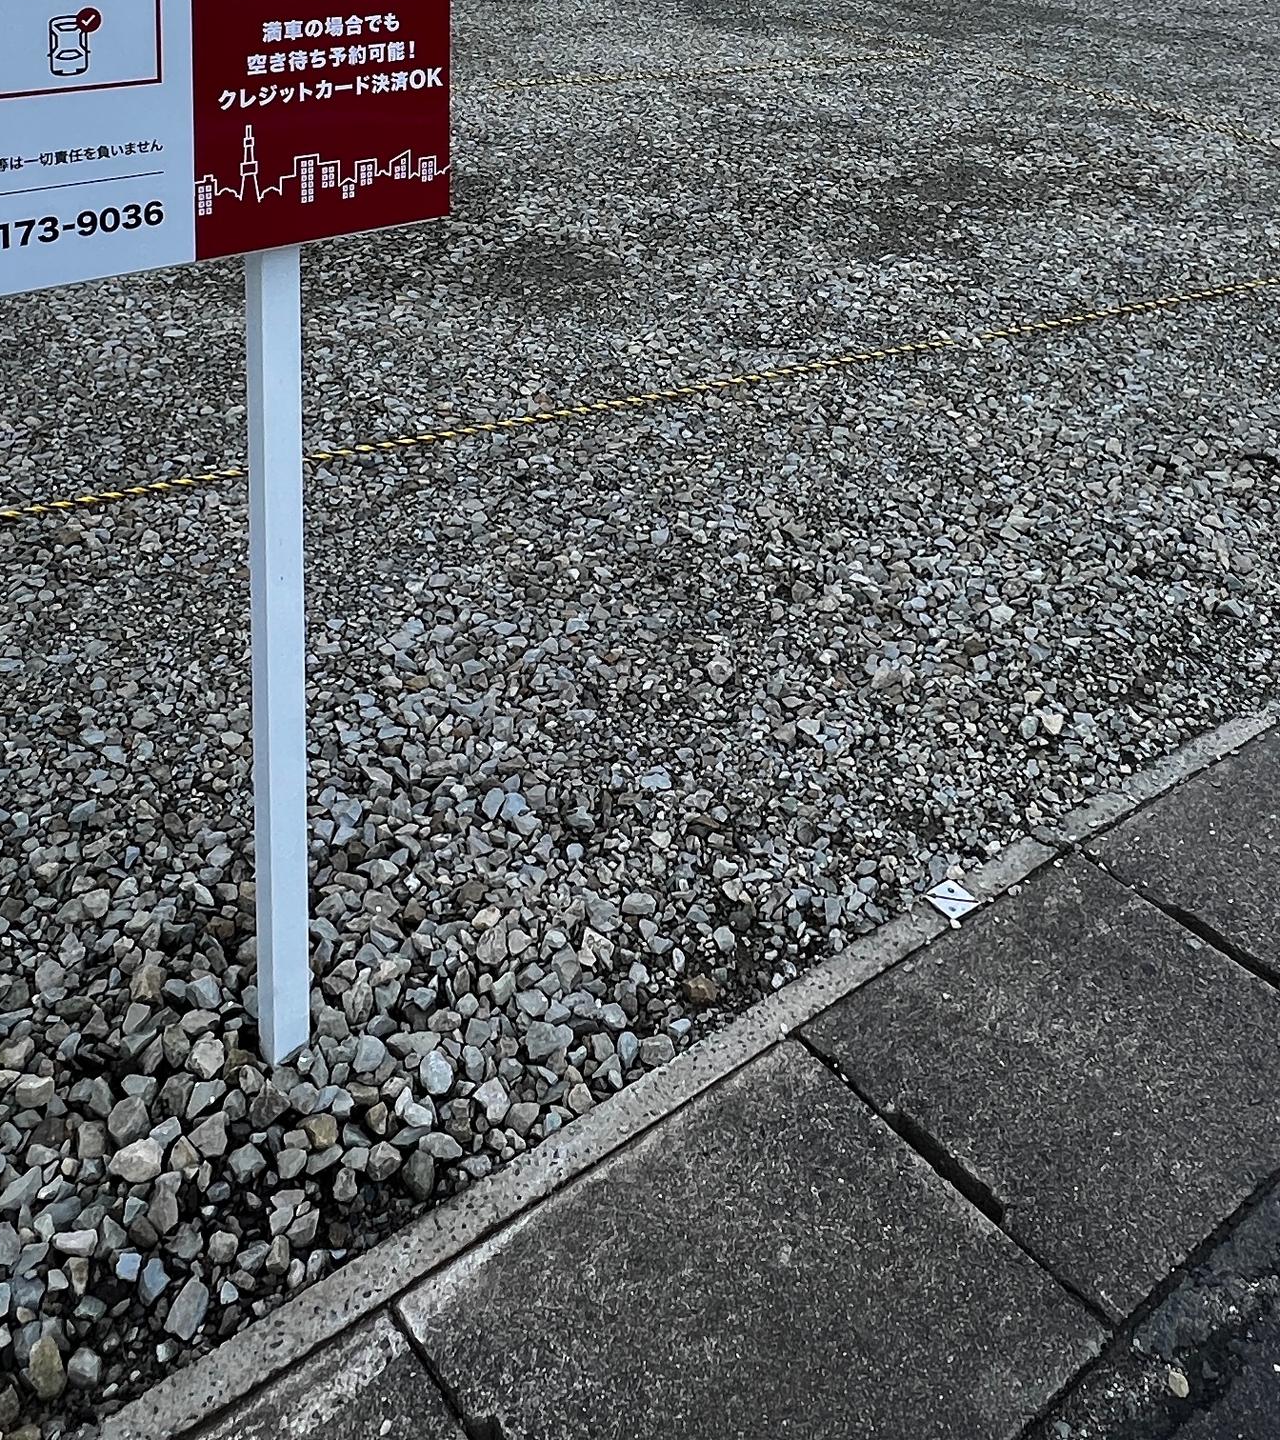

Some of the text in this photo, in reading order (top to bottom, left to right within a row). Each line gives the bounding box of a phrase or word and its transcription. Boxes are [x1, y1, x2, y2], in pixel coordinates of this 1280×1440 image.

[262, 13, 400, 43] 満車の場合でも
[218, 67, 444, 111] クレジットカード決済OK
